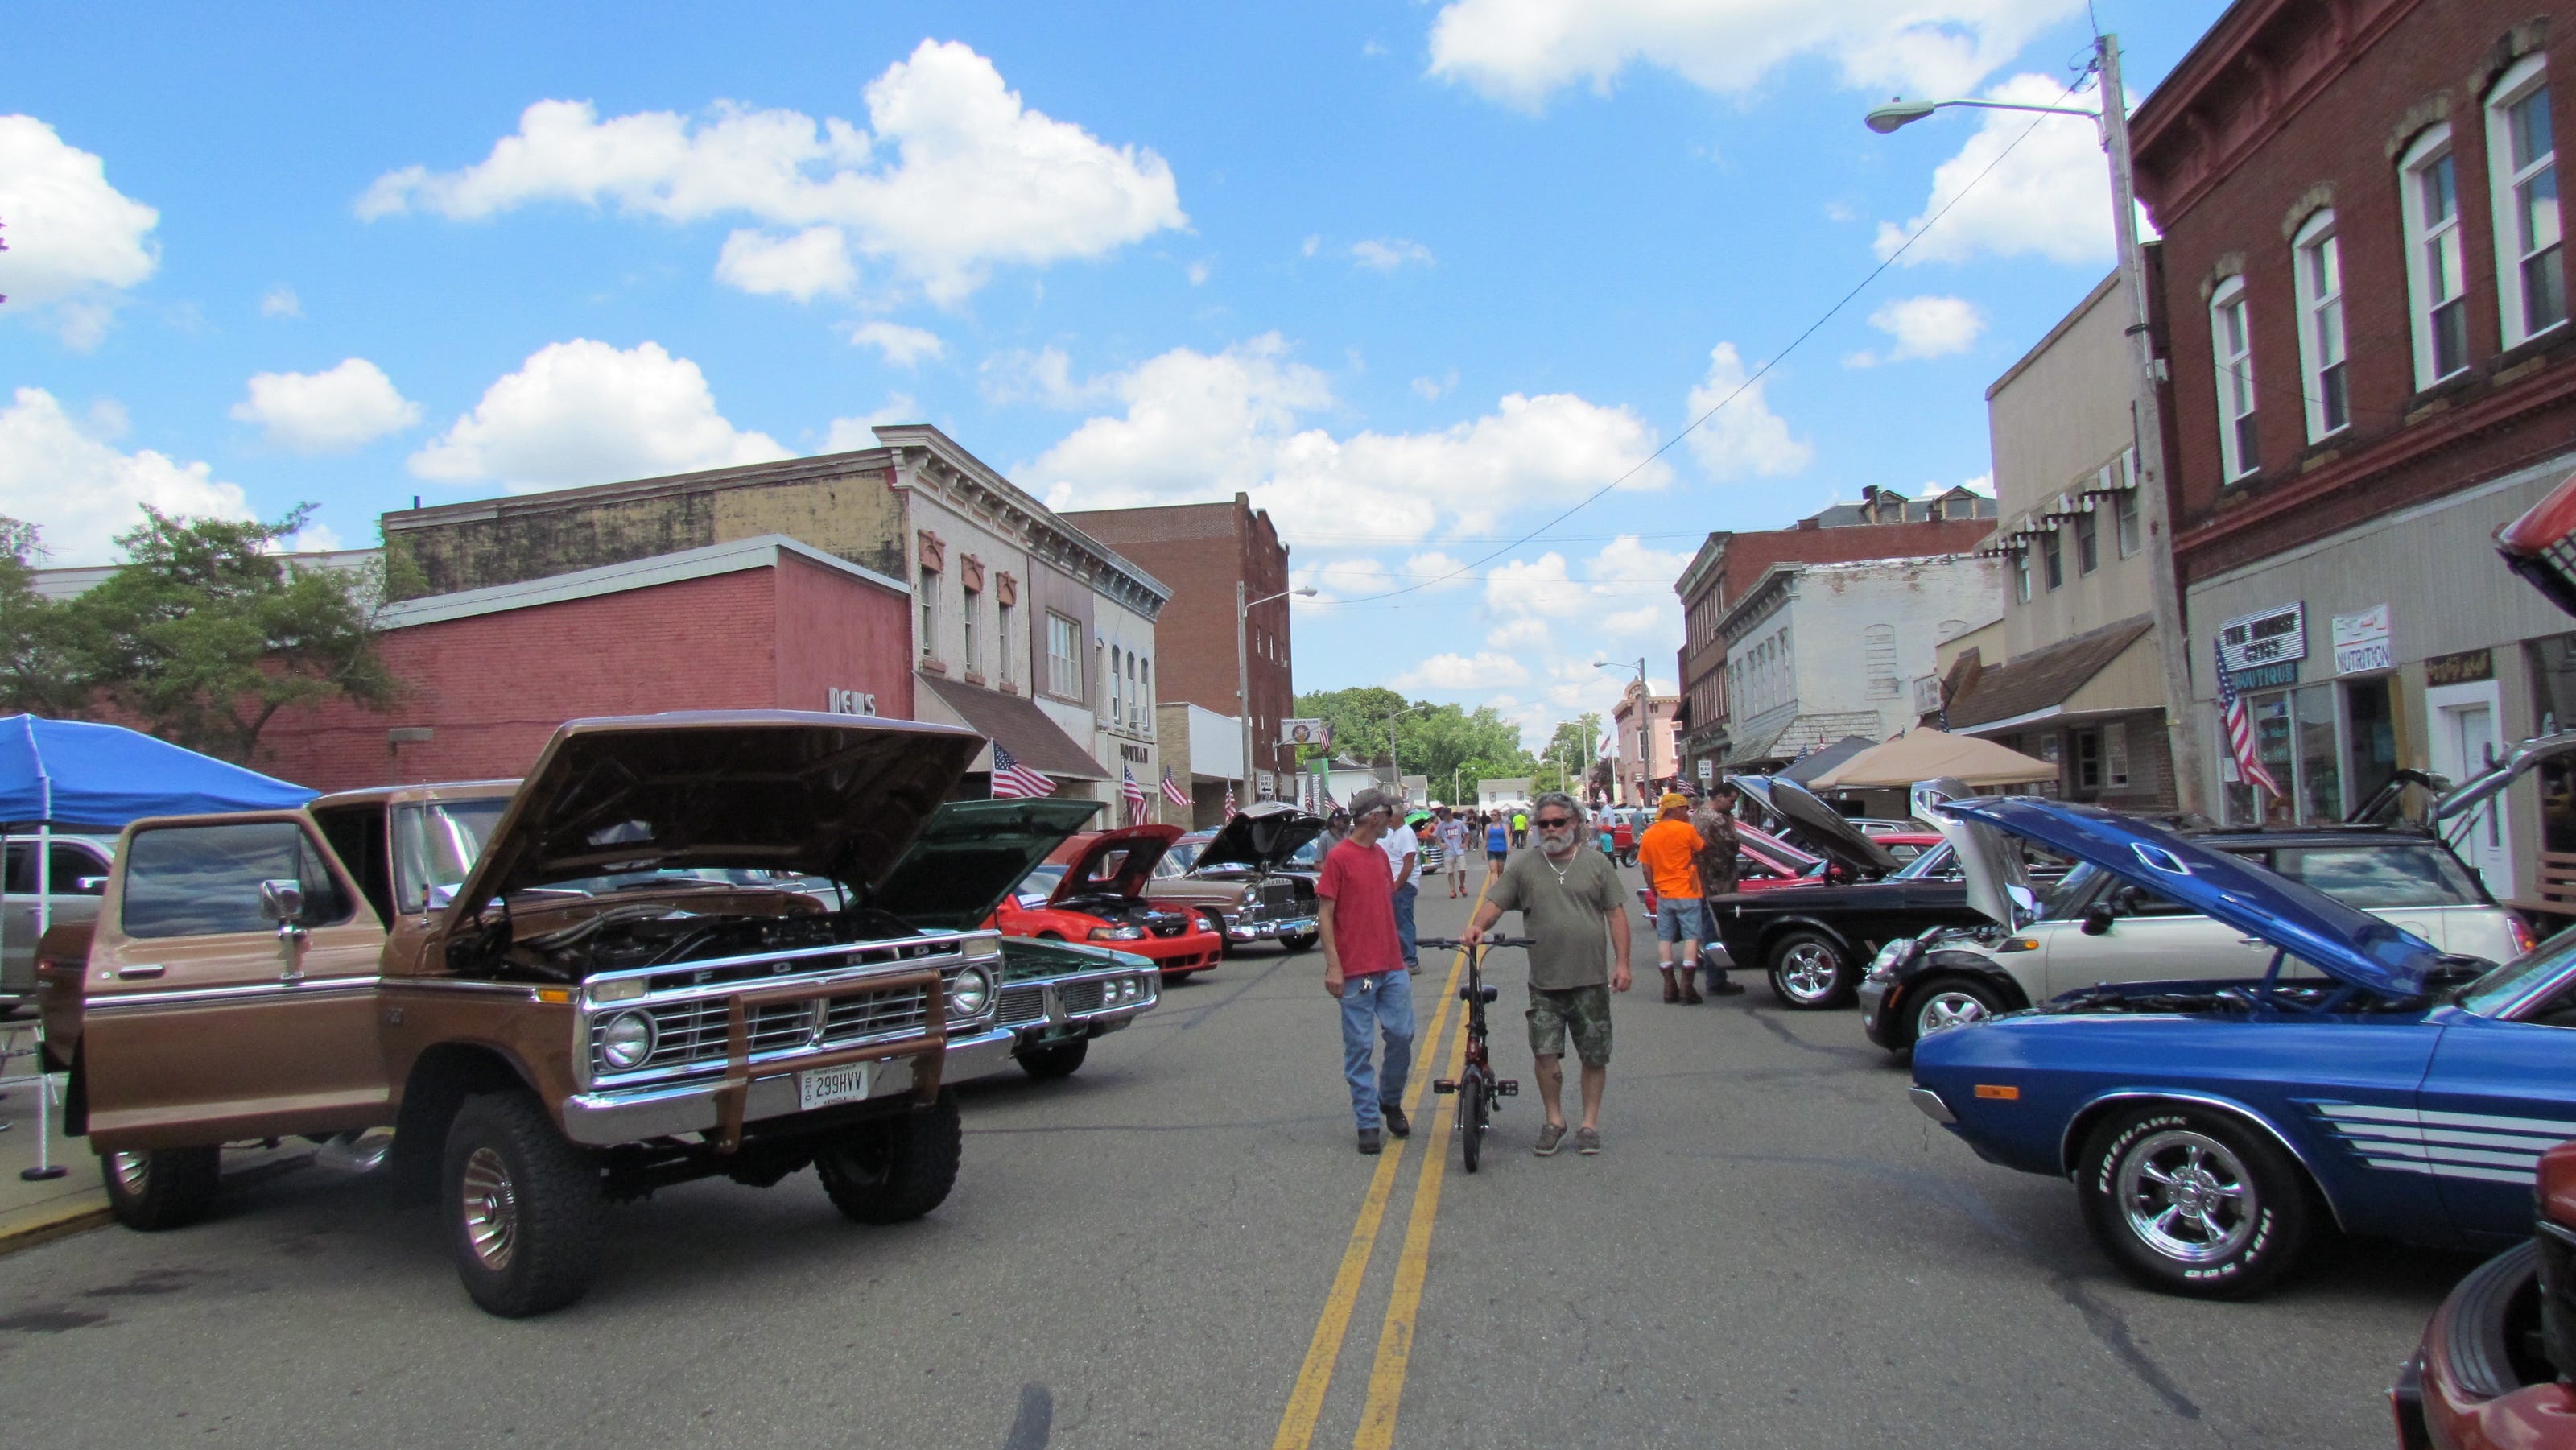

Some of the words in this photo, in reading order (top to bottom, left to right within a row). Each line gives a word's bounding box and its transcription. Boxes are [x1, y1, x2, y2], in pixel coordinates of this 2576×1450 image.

[2336, 646, 2389, 673] NUTRITION
[2235, 663, 2294, 690] BOUTIQUE
[694, 946, 930, 983] FORD
[816, 1070, 861, 1097] 299HVV
[2099, 1116, 2188, 1194] FIREHAWK
[2244, 1208, 2273, 1263] INDY
[2184, 1262, 2236, 1279] 500
